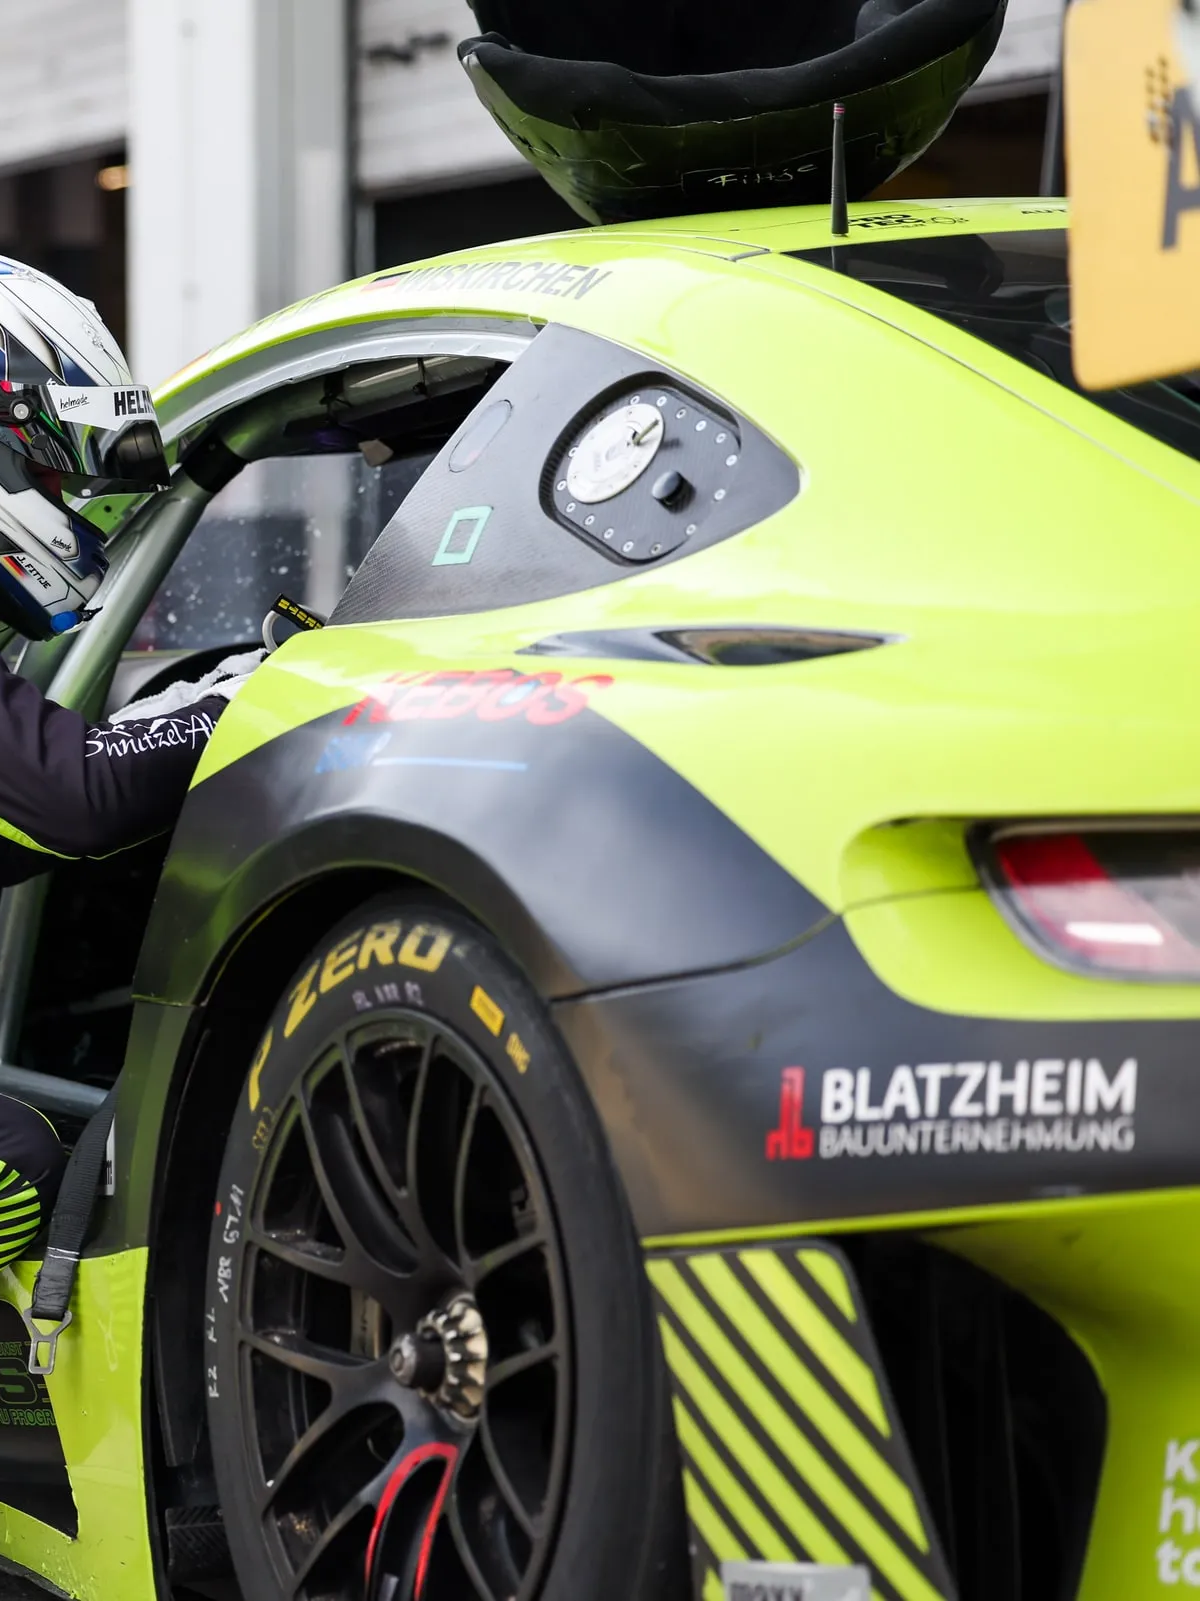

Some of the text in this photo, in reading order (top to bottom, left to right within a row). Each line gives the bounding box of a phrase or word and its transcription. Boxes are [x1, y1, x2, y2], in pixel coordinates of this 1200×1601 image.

[25, 563, 52, 589] FITTJE
[283, 919, 453, 1039] ZERO
[820, 1057, 1138, 1125] BLATZHEIM
[818, 1116, 1136, 1160] BAUUNTERNEHMUNG
